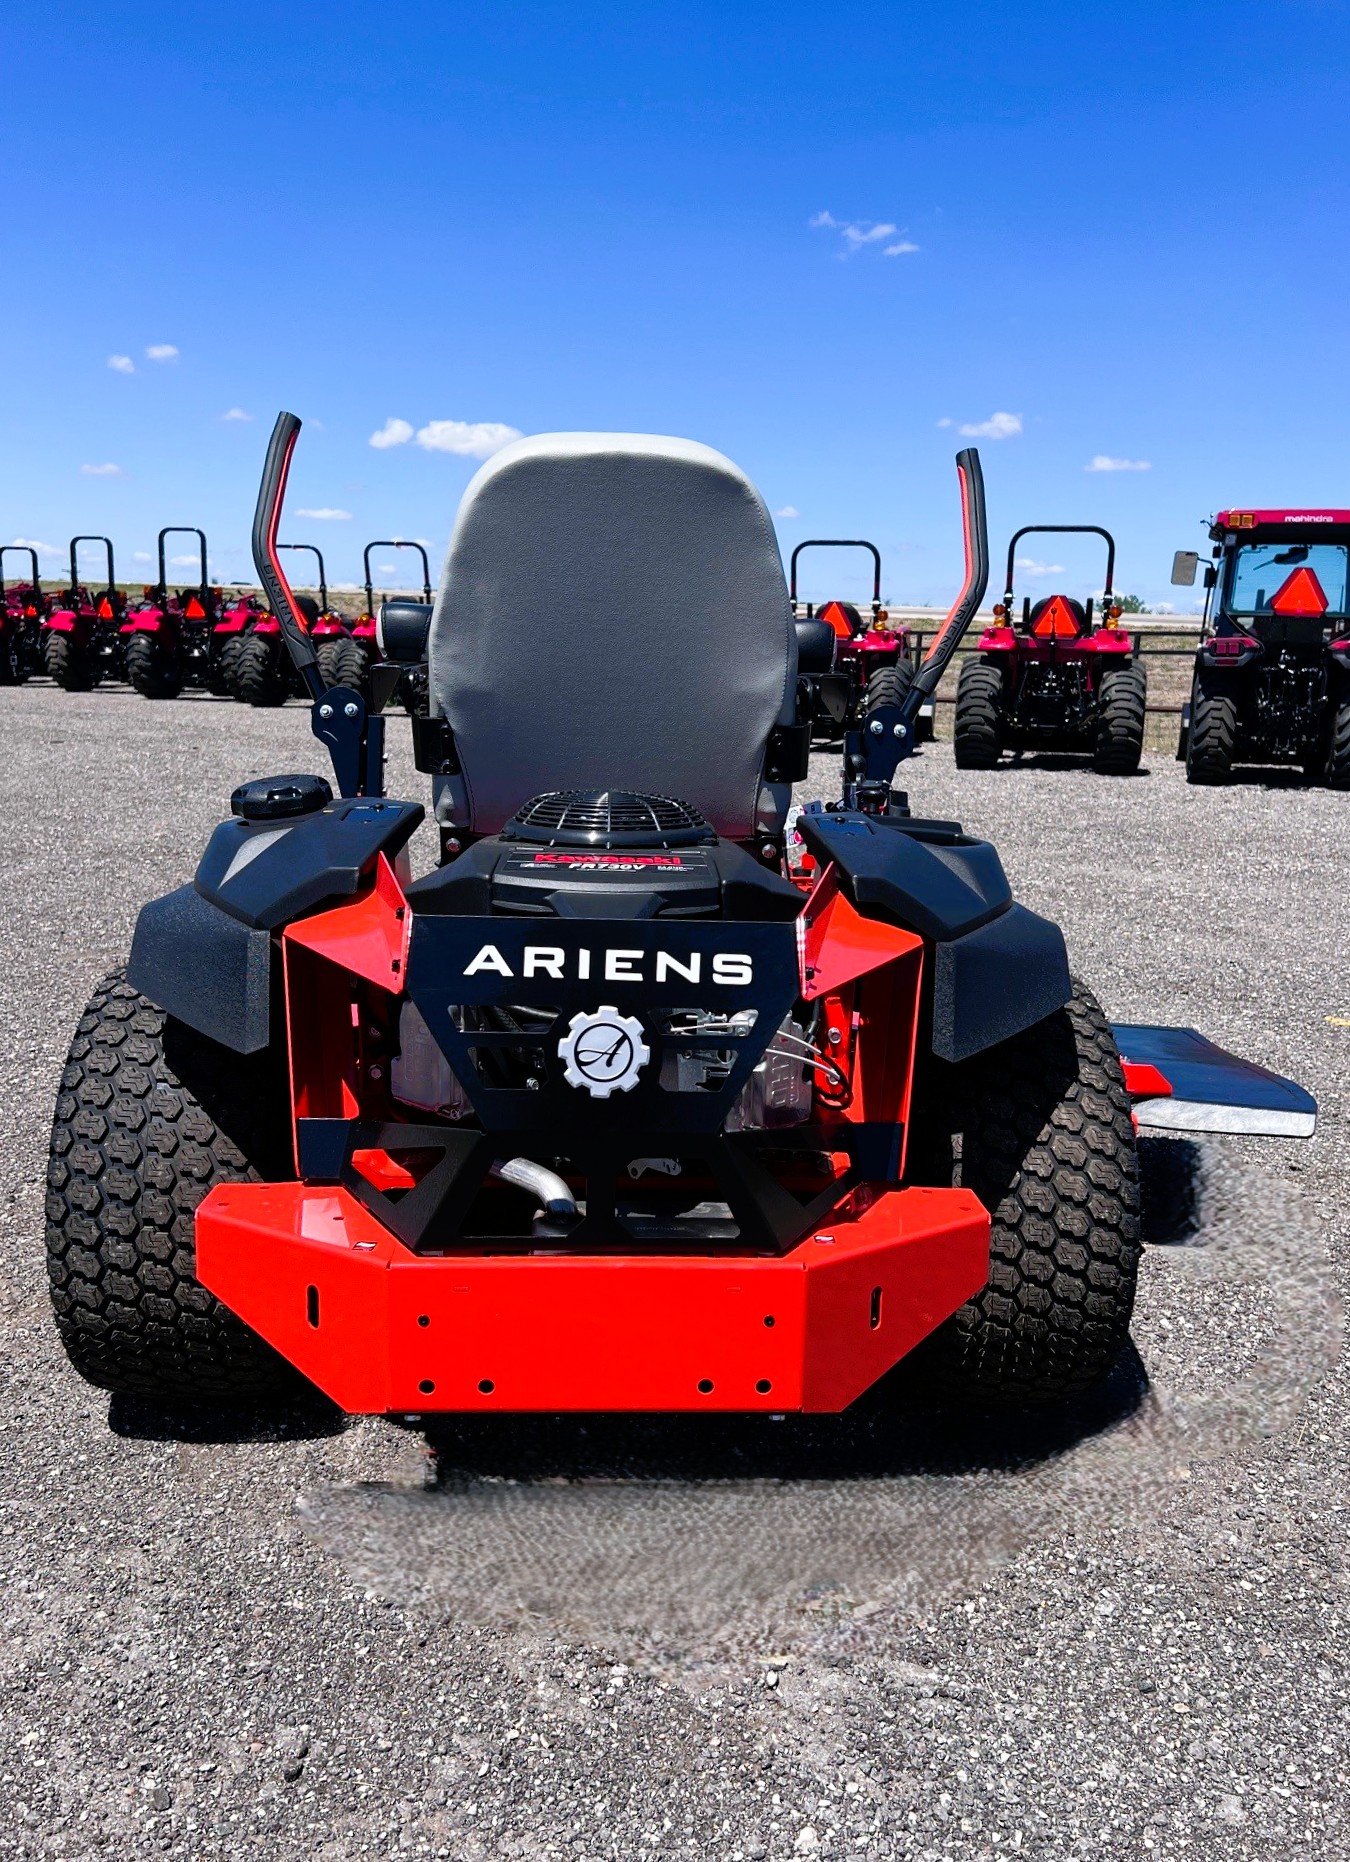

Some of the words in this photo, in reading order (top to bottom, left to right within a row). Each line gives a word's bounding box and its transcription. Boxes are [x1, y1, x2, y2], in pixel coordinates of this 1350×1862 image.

[263, 564, 298, 628] ARIENS
[935, 596, 971, 658] ARIENS
[534, 853, 682, 865] Kawasaki
[568, 862, 646, 870] FR730V
[463, 944, 753, 986] ARIENS
